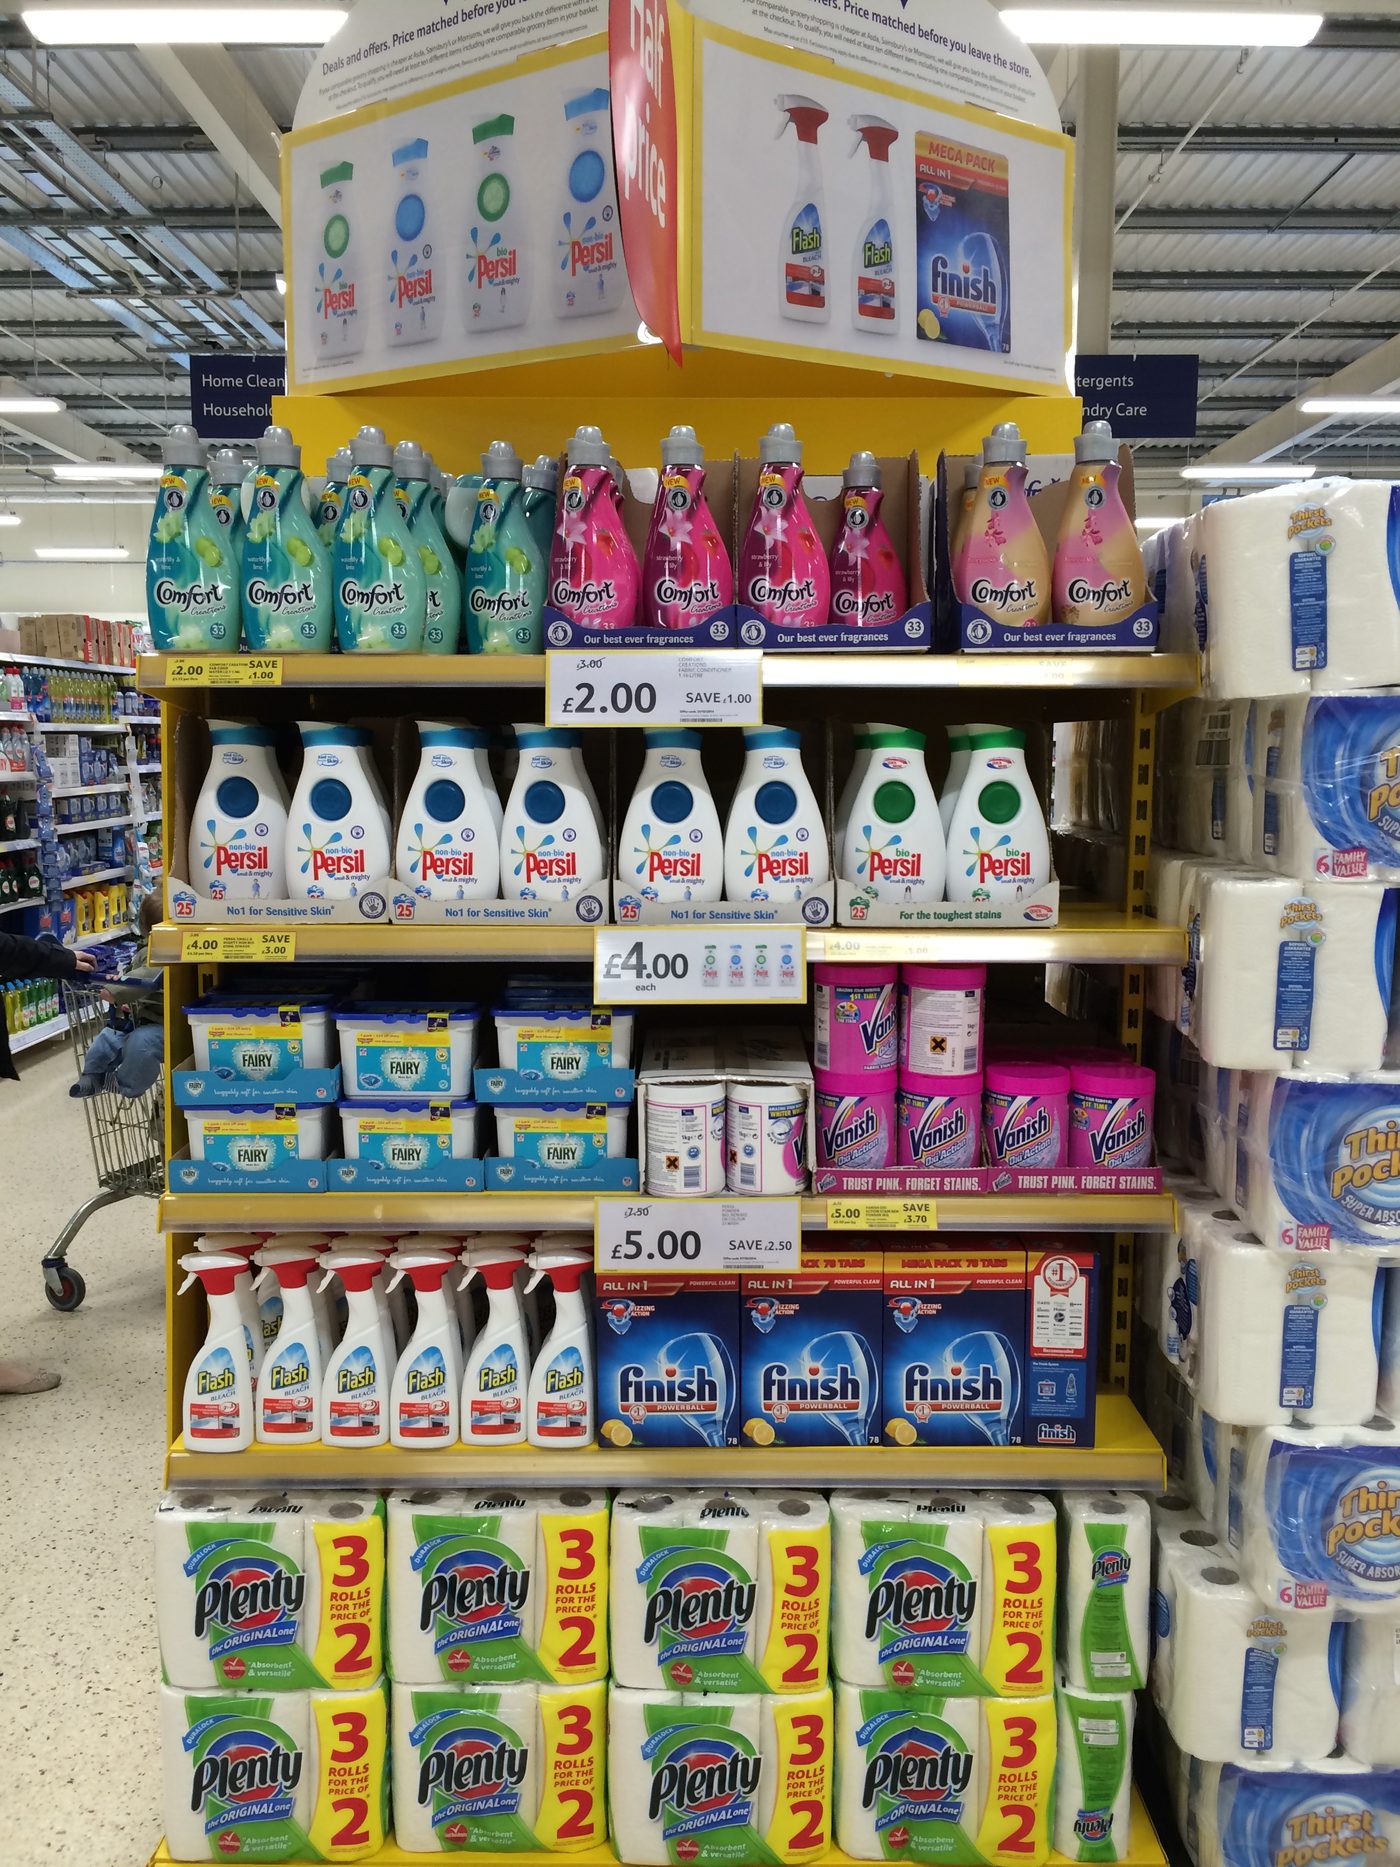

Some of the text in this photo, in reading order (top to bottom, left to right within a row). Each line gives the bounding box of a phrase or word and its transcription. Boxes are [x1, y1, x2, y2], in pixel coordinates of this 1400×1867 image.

[323, 56, 344, 76] Deals
[346, 49, 362, 67] and
[364, 40, 390, 60] offers.
[392, 31, 414, 48] Price
[416, 15, 459, 39] matched
[461, 3, 494, 22] before
[844, 0, 869, 21] Price
[872, 11, 916, 35] matched
[918, 24, 948, 47] before
[950, 38, 966, 54] you
[969, 42, 991, 63] leave
[993, 54, 1007, 69] the
[1009, 60, 1032, 78] store.
[920, 163, 936, 176] ALL
[937, 167, 946, 178] IN
[928, 141, 996, 173] MEGA PACK
[791, 227, 821, 254] Flash
[572, 233, 613, 277] Persil
[864, 242, 892, 268] Flash
[478, 250, 516, 289] Persil
[932, 255, 997, 304] finish
[324, 284, 355, 319] Persil
[398, 269, 432, 309] Persil
[202, 374, 243, 387] Home
[1074, 375, 1134, 390] tergents
[1116, 403, 1147, 416] Care
[1287, 516, 1333, 541] Pockets
[1290, 506, 1326, 524] Thirst
[156, 580, 224, 613] Comfort
[341, 578, 405, 613] Comfort
[553, 580, 616, 612] Comfort
[971, 579, 1037, 611] Comfort
[583, 633, 694, 647] Our best ever fragrances
[712, 624, 726, 635] 33
[249, 660, 278, 668] SAVE
[562, 682, 657, 714] £2.00
[686, 692, 720, 704] SAVE
[229, 843, 257, 851] non-bio
[1006, 847, 1020, 857] bio
[216, 846, 268, 876] Persil
[422, 851, 473, 882] Persil
[649, 851, 701, 883] Persil
[758, 852, 809, 884] Persil
[979, 852, 1030, 884] Persil
[176, 902, 193, 916] 25
[227, 906, 244, 916] No1
[249, 906, 262, 916] for
[266, 906, 308, 917] Sensitive
[900, 911, 1002, 922] For the toughest stains
[262, 935, 290, 943] SAVE
[603, 942, 689, 979] £4.00
[635, 984, 656, 992] each
[242, 1054, 273, 1068] FAIRY
[390, 1061, 421, 1075] FAIRY
[550, 1056, 581, 1070] FAIRY
[822, 1104, 879, 1161] Vanish
[908, 1104, 967, 1161] Vanish
[993, 1105, 1050, 1160] Vanish
[1088, 1108, 1147, 1164] Vanish
[237, 1149, 268, 1162] FAIRY
[852, 1138, 879, 1160] Action
[843, 1176, 982, 1191] TRUST PINK. FORGET STAINS.
[830, 1208, 860, 1219] £5.00
[902, 1203, 930, 1212] SAVE
[611, 1230, 702, 1260] £5.00
[728, 1239, 762, 1251] SAVE
[1282, 1226, 1330, 1246] 6 FAMILY
[1298, 1237, 1329, 1248] VALUE
[981, 1258, 1008, 1268] TABS
[603, 1280, 648, 1291] ALL IN 1
[630, 1304, 656, 1312] FIZZING
[197, 1368, 235, 1396] Flash
[271, 1362, 310, 1391] Flash
[546, 1366, 584, 1394] Flash
[619, 1363, 719, 1403] finish
[763, 1362, 861, 1402] finish
[284, 1385, 310, 1396] BLEACH
[559, 1389, 584, 1400] BLEACH
[727, 1437, 738, 1445] 78
[1038, 1424, 1076, 1440] finish
[187, 1544, 216, 1570] DURALOCK
[332, 1535, 370, 1588] 3
[1091, 1557, 1132, 1580] Plenty
[1336, 1550, 1367, 1575] SUPER
[195, 1569, 306, 1638] Plenty
[330, 1587, 371, 1602] ROLLS
[330, 1600, 371, 1611] FOR THE
[420, 1564, 530, 1632] Plenty
[864, 1576, 979, 1640] Plenty
[330, 1608, 371, 1621] PRICE OF
[644, 1579, 757, 1644] Plenty
[211, 1628, 295, 1655] the ORIGINAL one
[334, 1622, 372, 1673] 2
[191, 1746, 303, 1812] Plenty
[418, 1742, 528, 1805] Plenty
[649, 1752, 763, 1820] Plenty
[862, 1746, 975, 1810] Plenty
[1287, 1807, 1374, 1841] Thirst
[1275, 1831, 1390, 1867] Pockets
